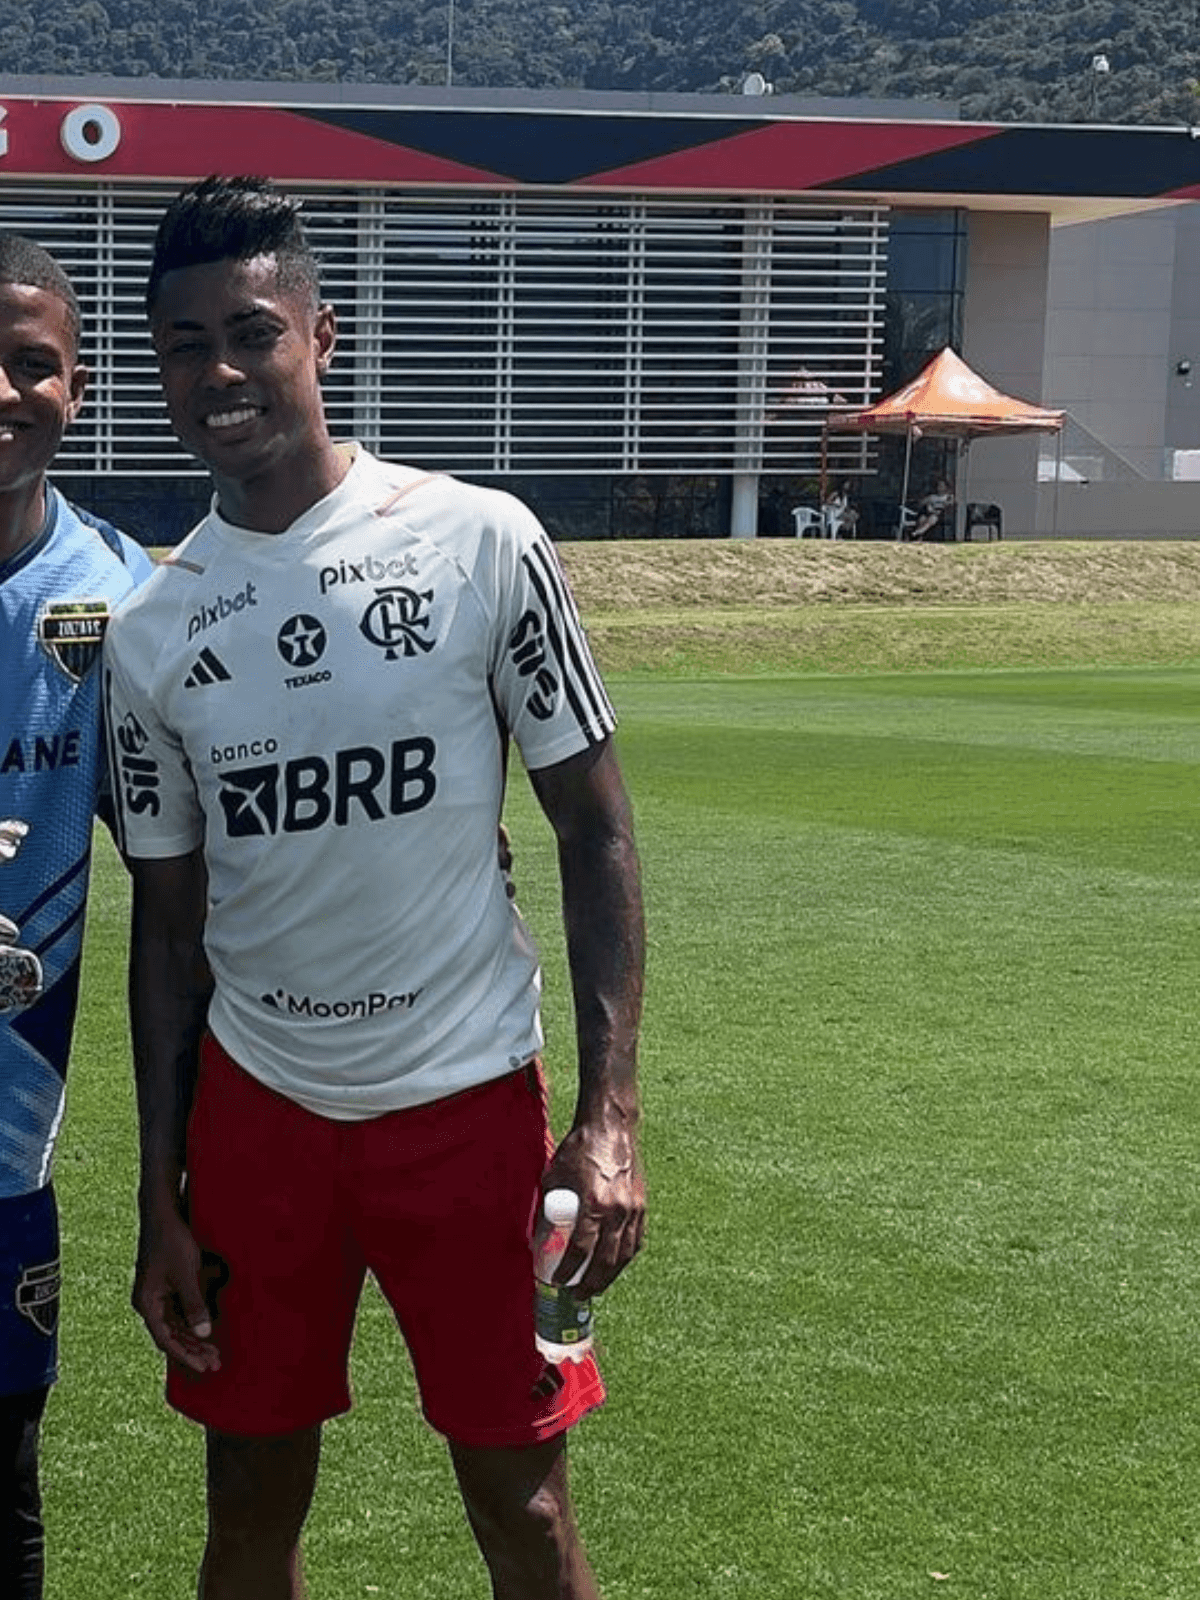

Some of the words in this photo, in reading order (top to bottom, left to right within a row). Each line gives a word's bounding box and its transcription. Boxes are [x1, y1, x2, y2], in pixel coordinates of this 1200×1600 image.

[320, 554, 420, 595] pixbet
[187, 581, 258, 643] pixbet
[284, 670, 332, 689] TEXACO
[210, 738, 278, 764] banco
[283, 736, 437, 833] BRB
[287, 987, 425, 1017] MoonPay
